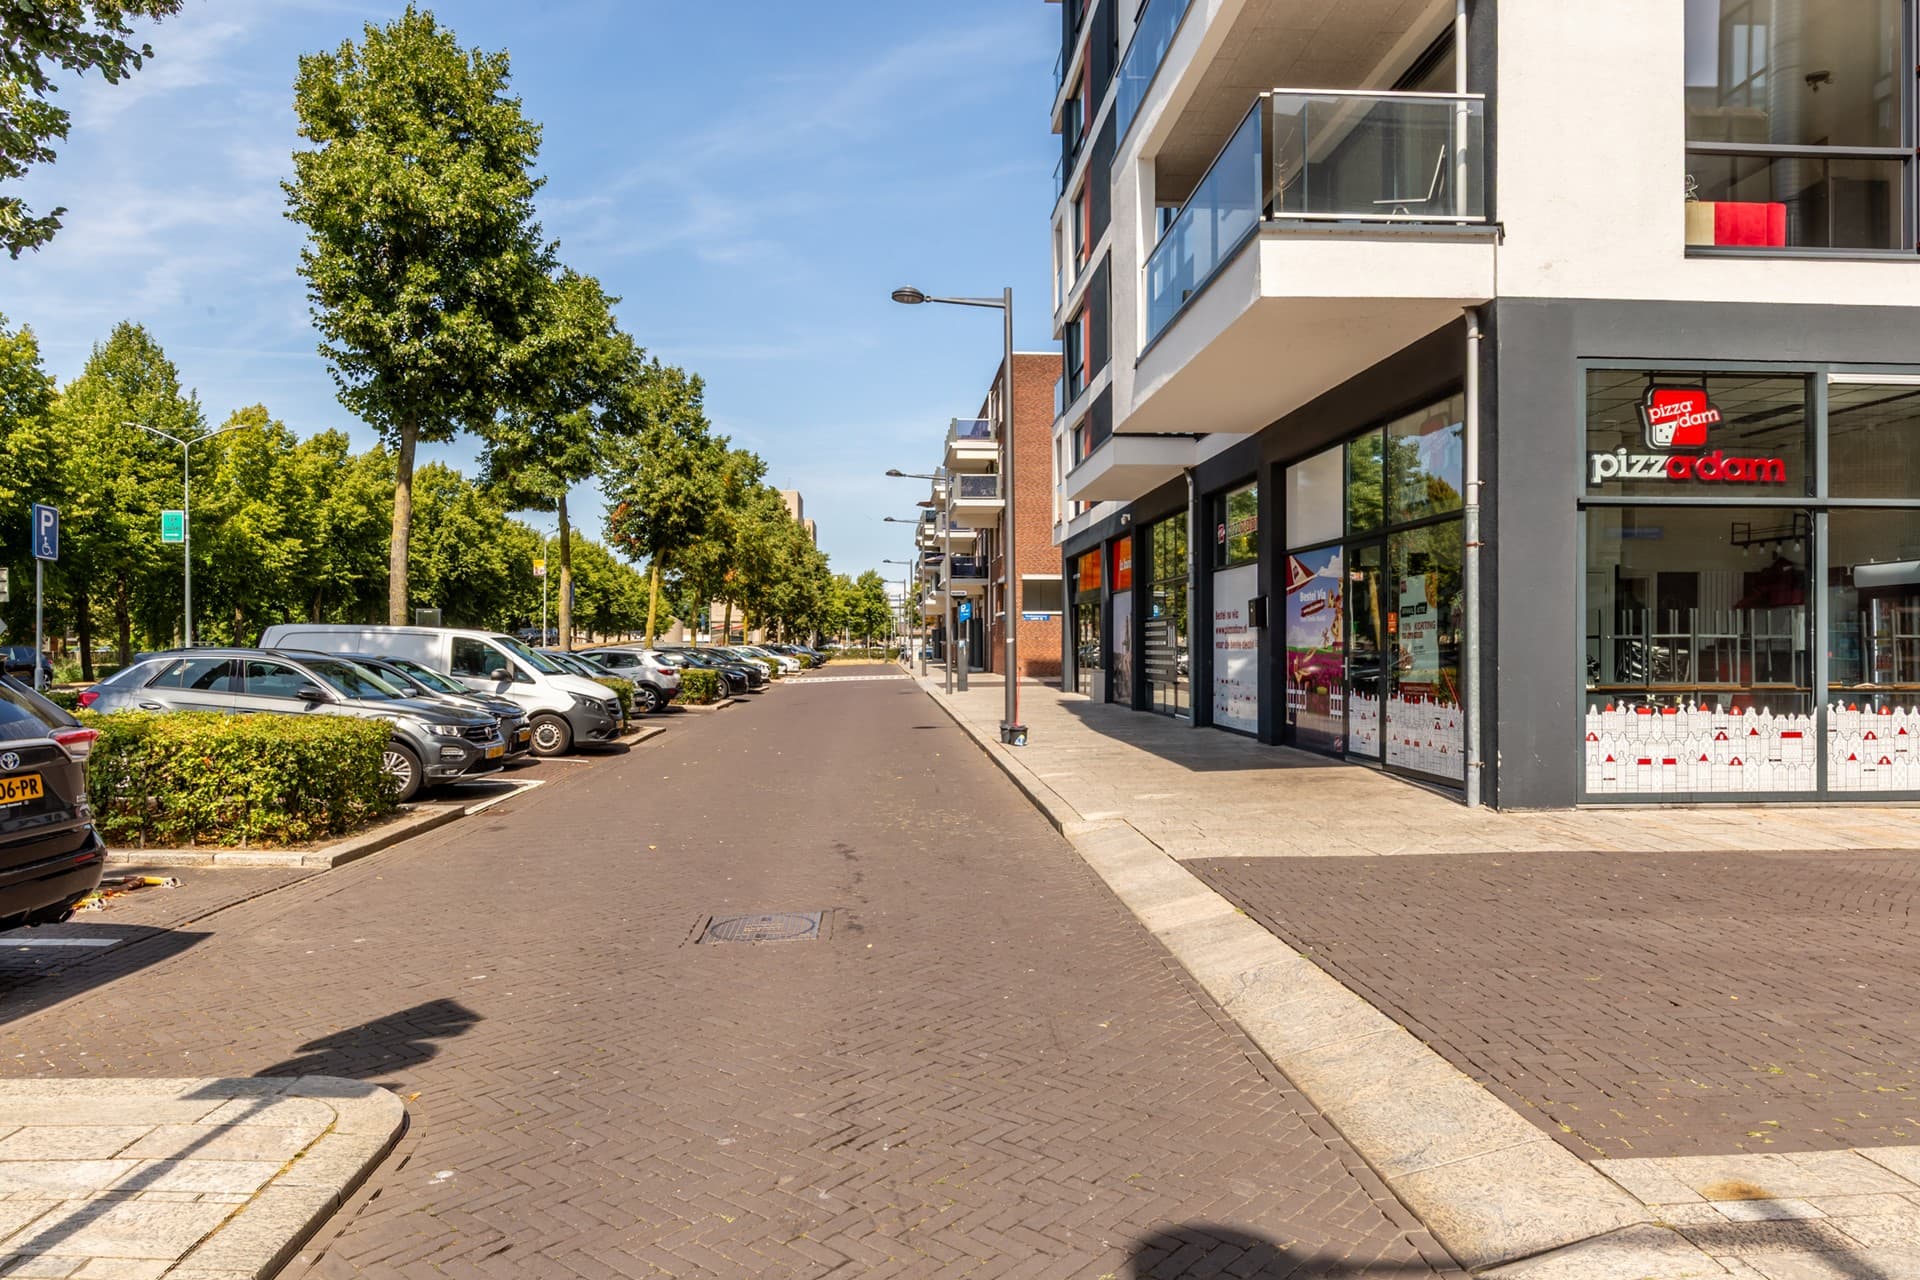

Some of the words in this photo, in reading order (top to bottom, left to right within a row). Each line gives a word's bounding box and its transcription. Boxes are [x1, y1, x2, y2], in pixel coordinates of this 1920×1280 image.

[1649, 400, 1693, 423] pizza
[1679, 408, 1720, 428] dam
[1591, 448, 1786, 484] pizzadam
[41, 510, 54, 536] P
